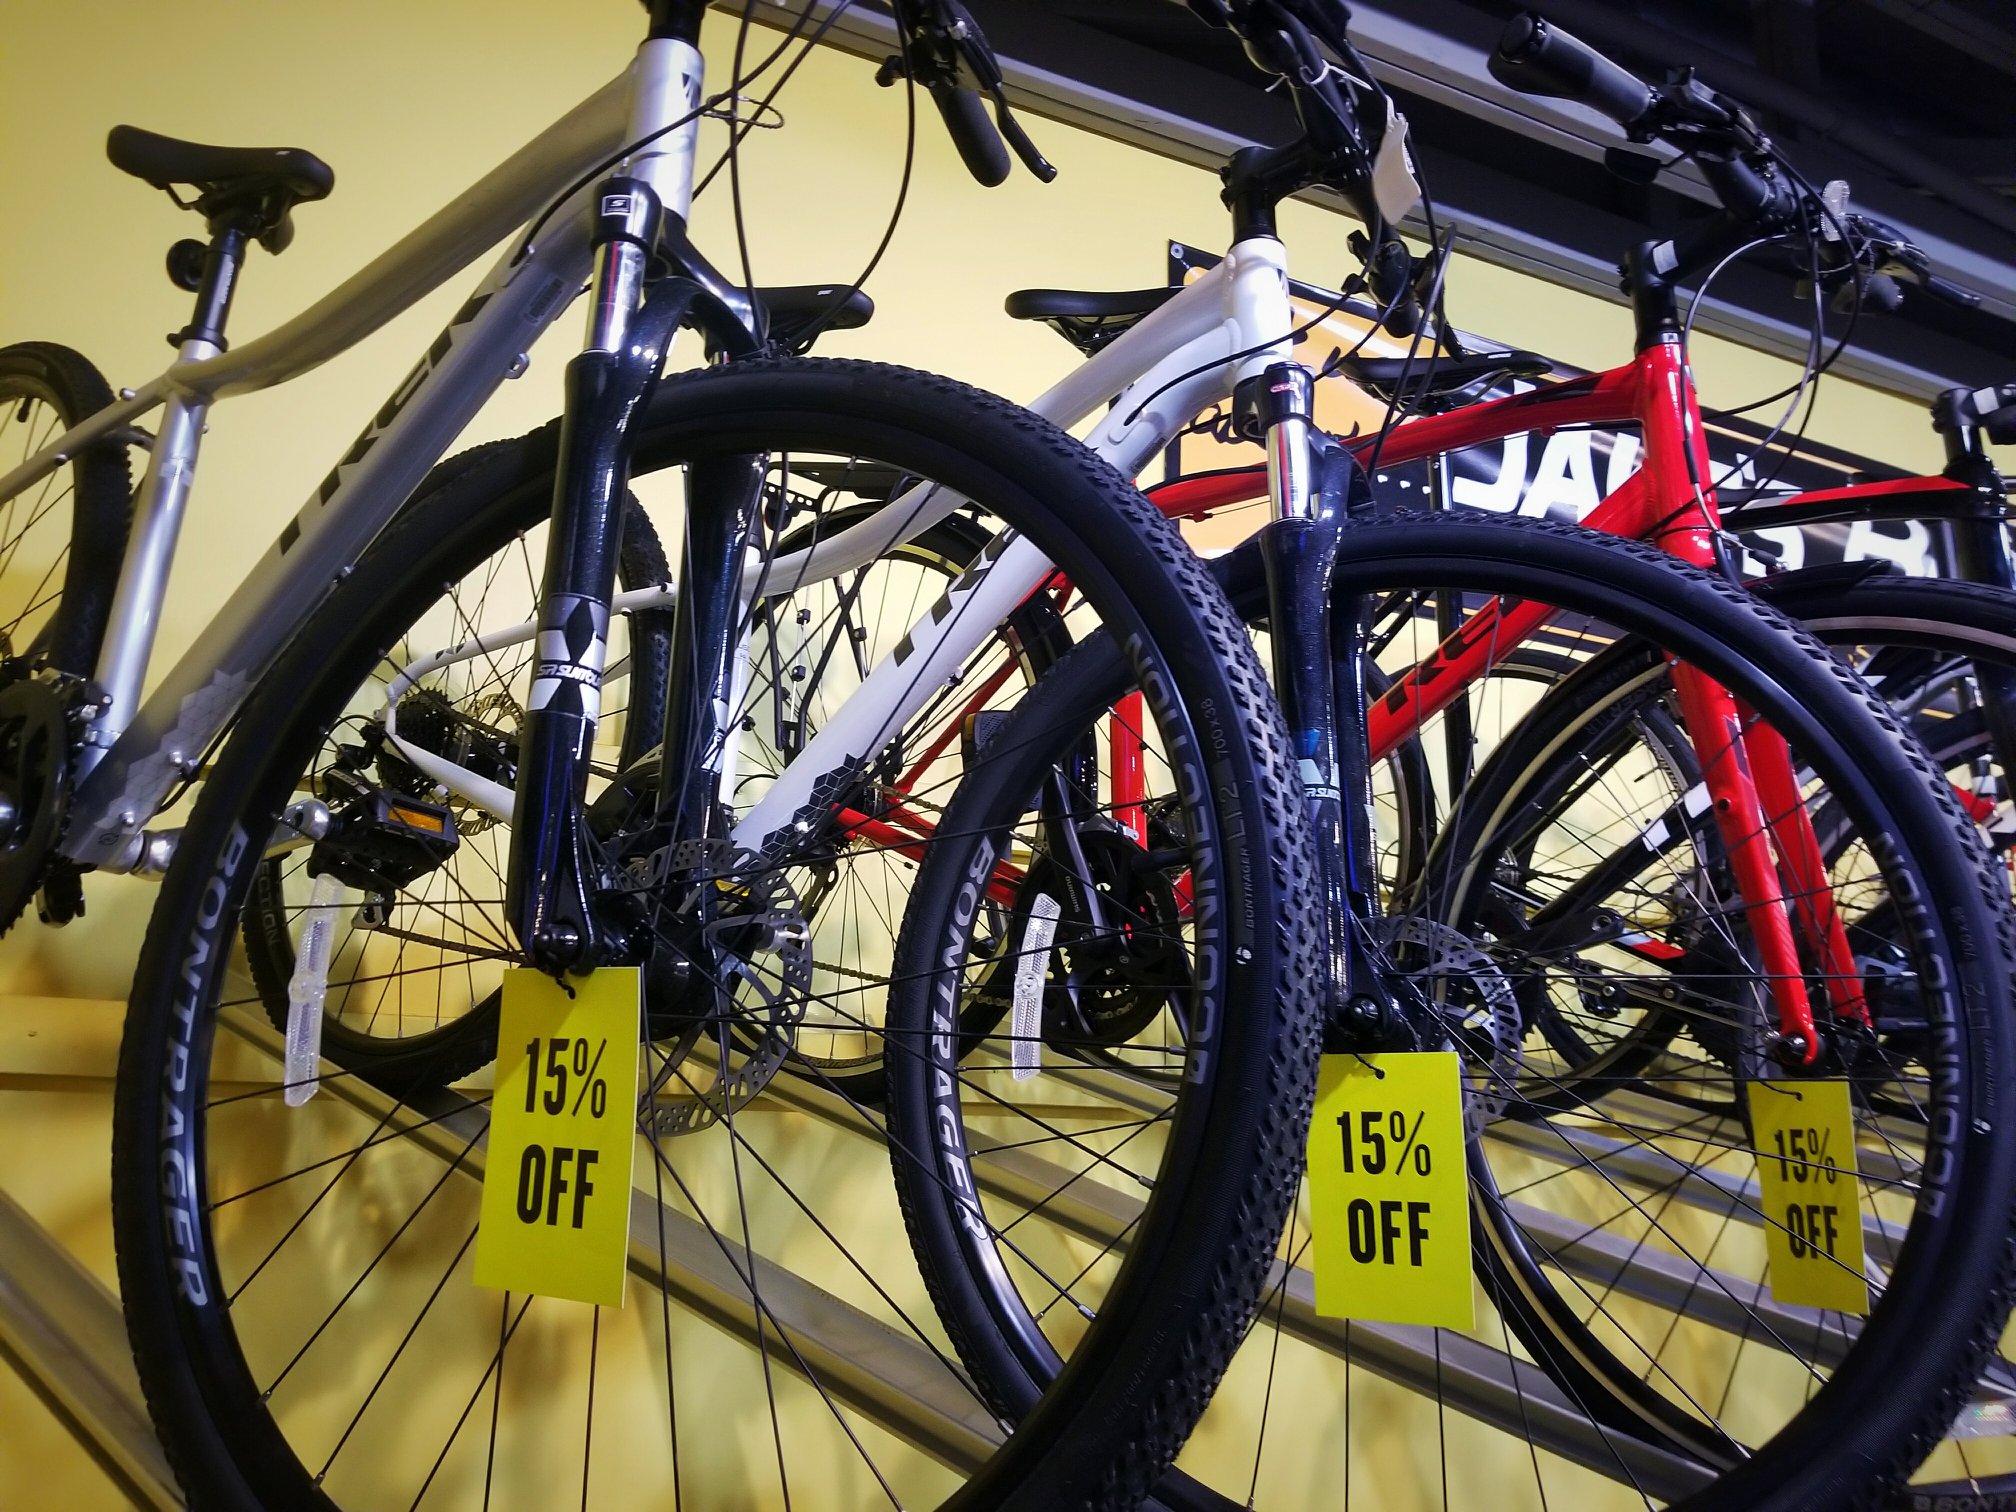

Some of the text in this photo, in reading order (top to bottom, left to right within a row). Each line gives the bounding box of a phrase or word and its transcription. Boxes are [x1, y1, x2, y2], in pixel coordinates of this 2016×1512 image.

[1123, 631, 1220, 1042] CONNECTION
[160, 818, 249, 1307] BONTRAGER
[526, 1037, 607, 1119] 15%
[932, 835, 996, 1241] BONTRAGER
[1336, 1110, 1431, 1177] 15%
[1774, 1127, 1836, 1184] 15%
[516, 1143, 599, 1229] OFF
[1347, 1198, 1430, 1267] OFF
[1786, 1203, 1838, 1259] OFF
